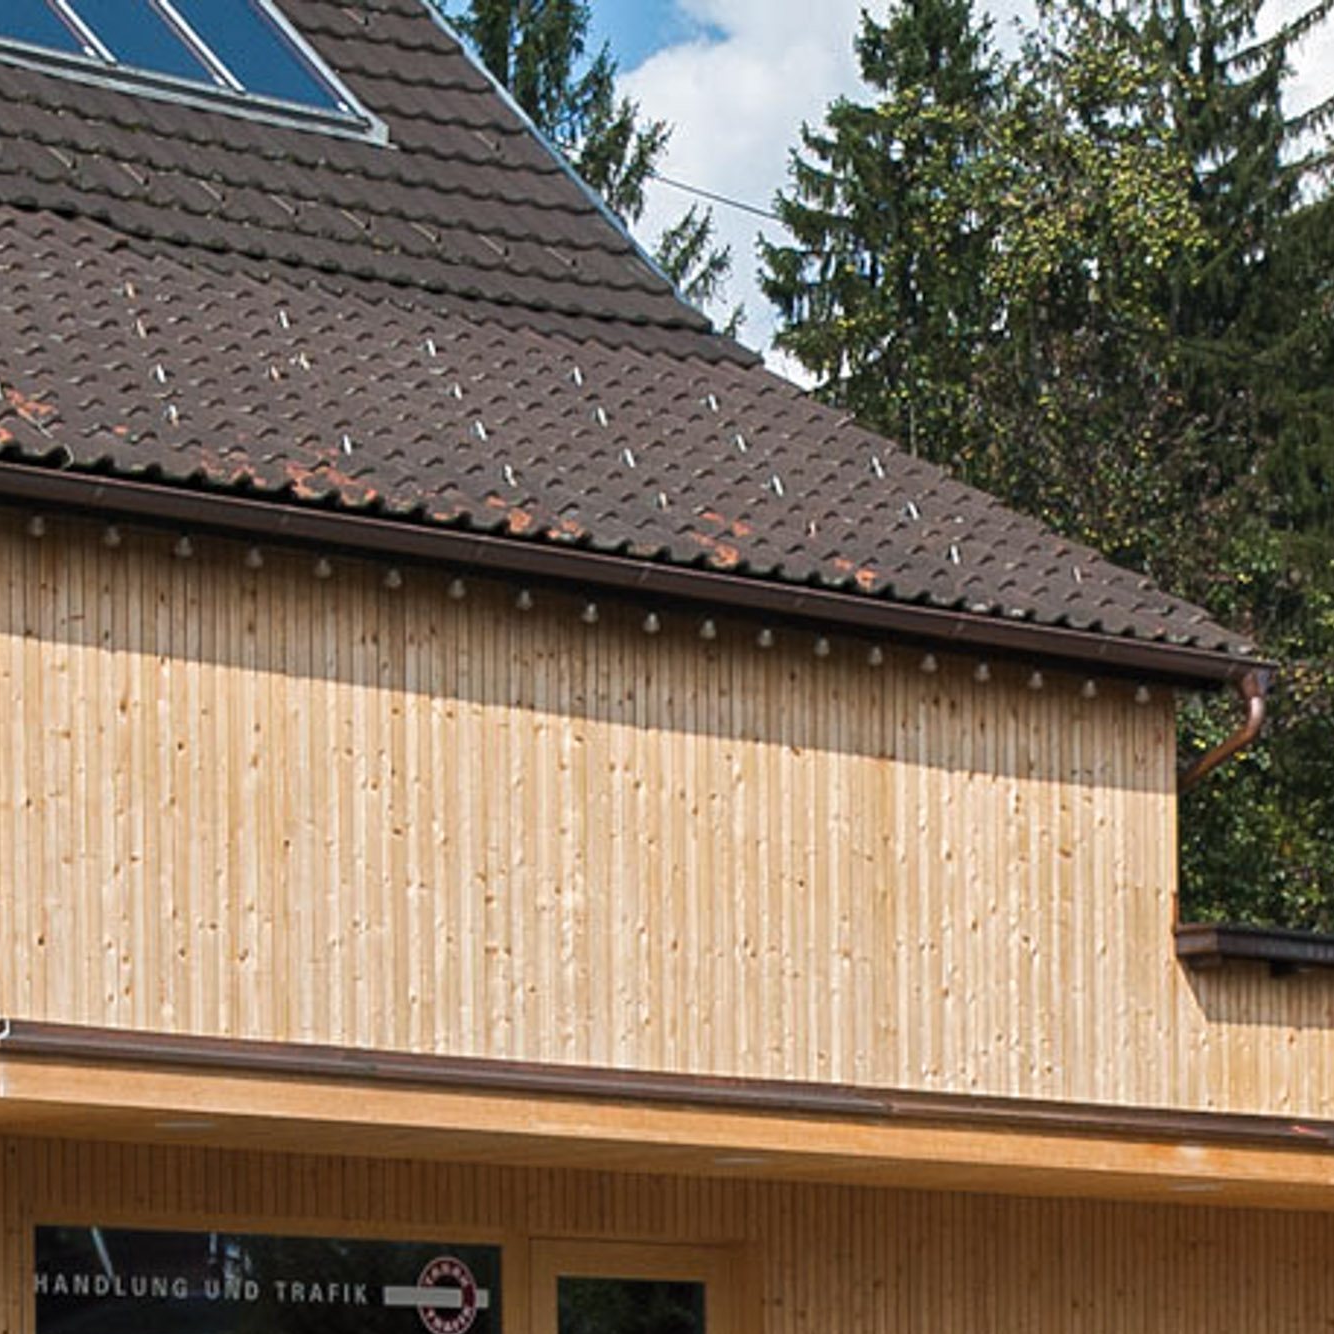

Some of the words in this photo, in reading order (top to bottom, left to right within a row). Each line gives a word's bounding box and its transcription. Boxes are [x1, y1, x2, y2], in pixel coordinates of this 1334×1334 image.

[33, 1273, 189, 1299] HANDLUNG
[204, 1278, 260, 1300] UND
[274, 1280, 368, 1305] TRAFIK
